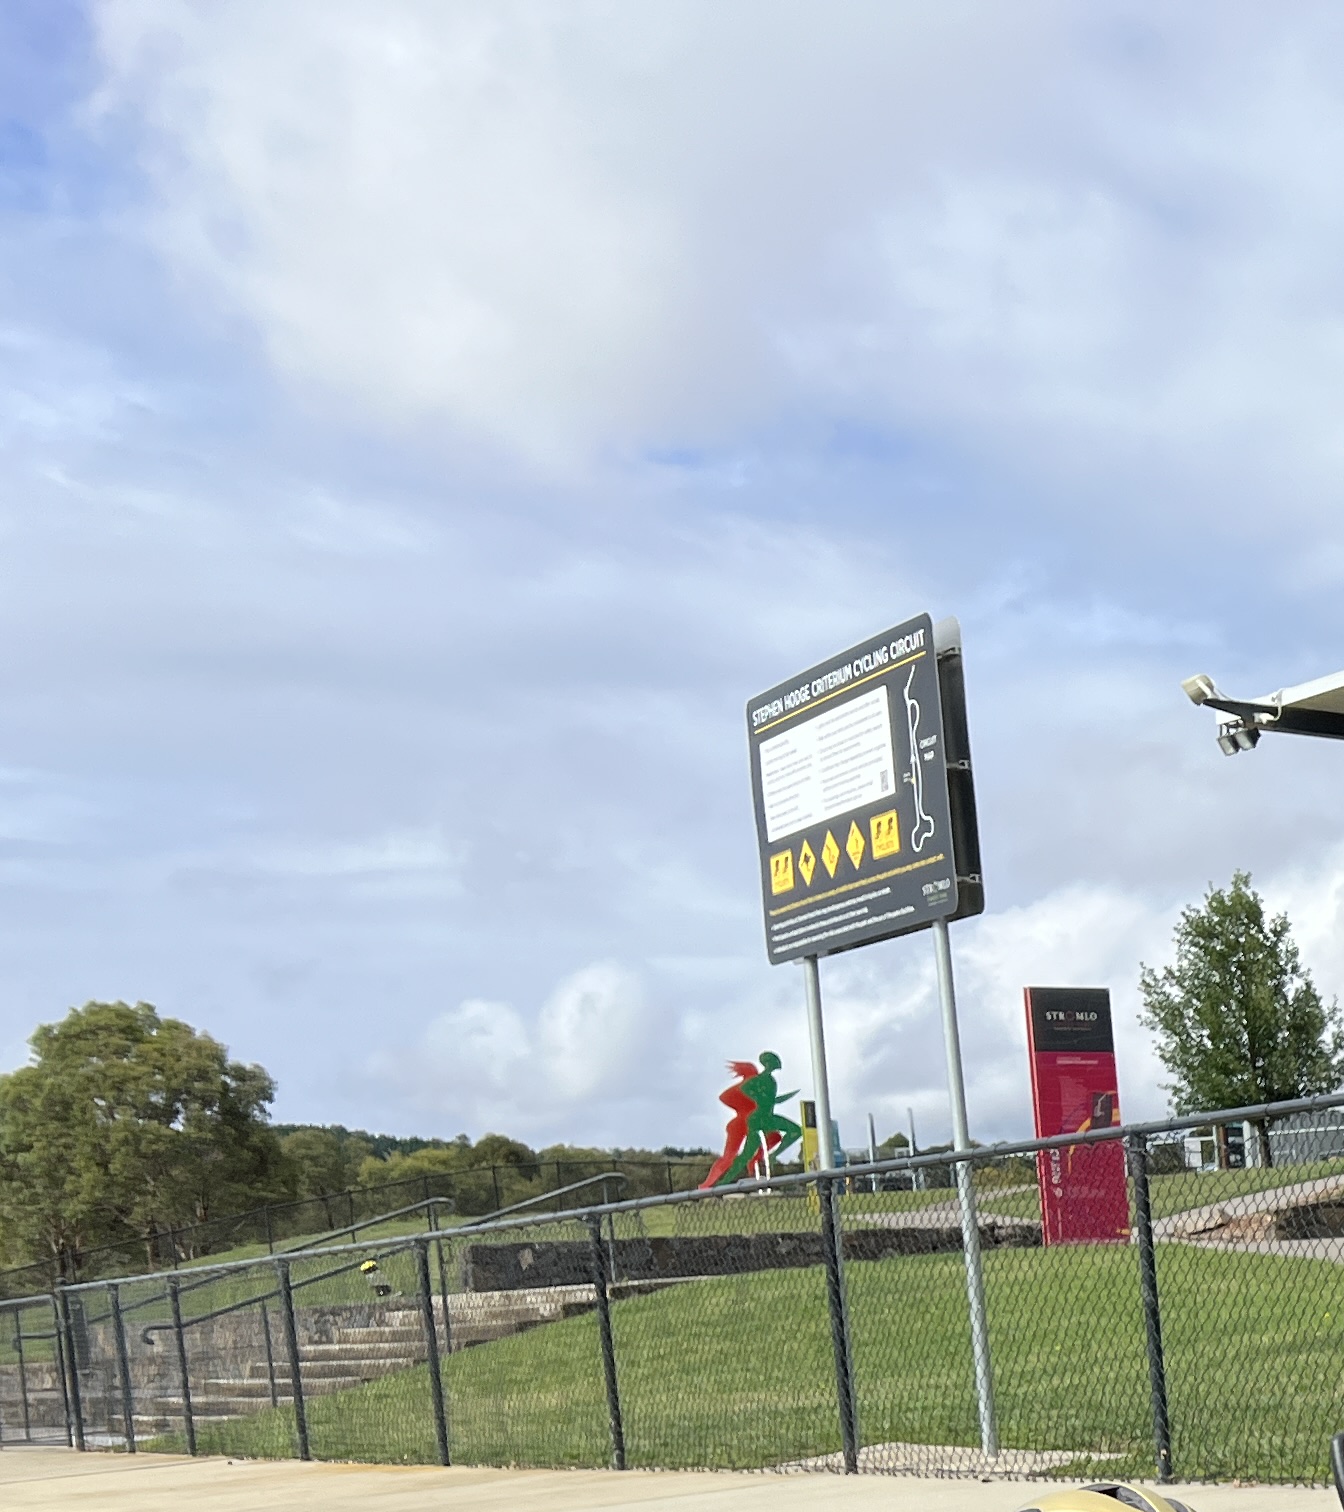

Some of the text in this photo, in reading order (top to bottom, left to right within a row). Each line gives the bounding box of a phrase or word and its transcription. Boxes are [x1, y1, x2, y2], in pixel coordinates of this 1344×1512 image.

[752, 697, 783, 727] STEPHEN
[811, 664, 853, 697] CRITERIUM
[853, 646, 889, 677] CYCLING
[889, 629, 925, 659] CIRCUIT
